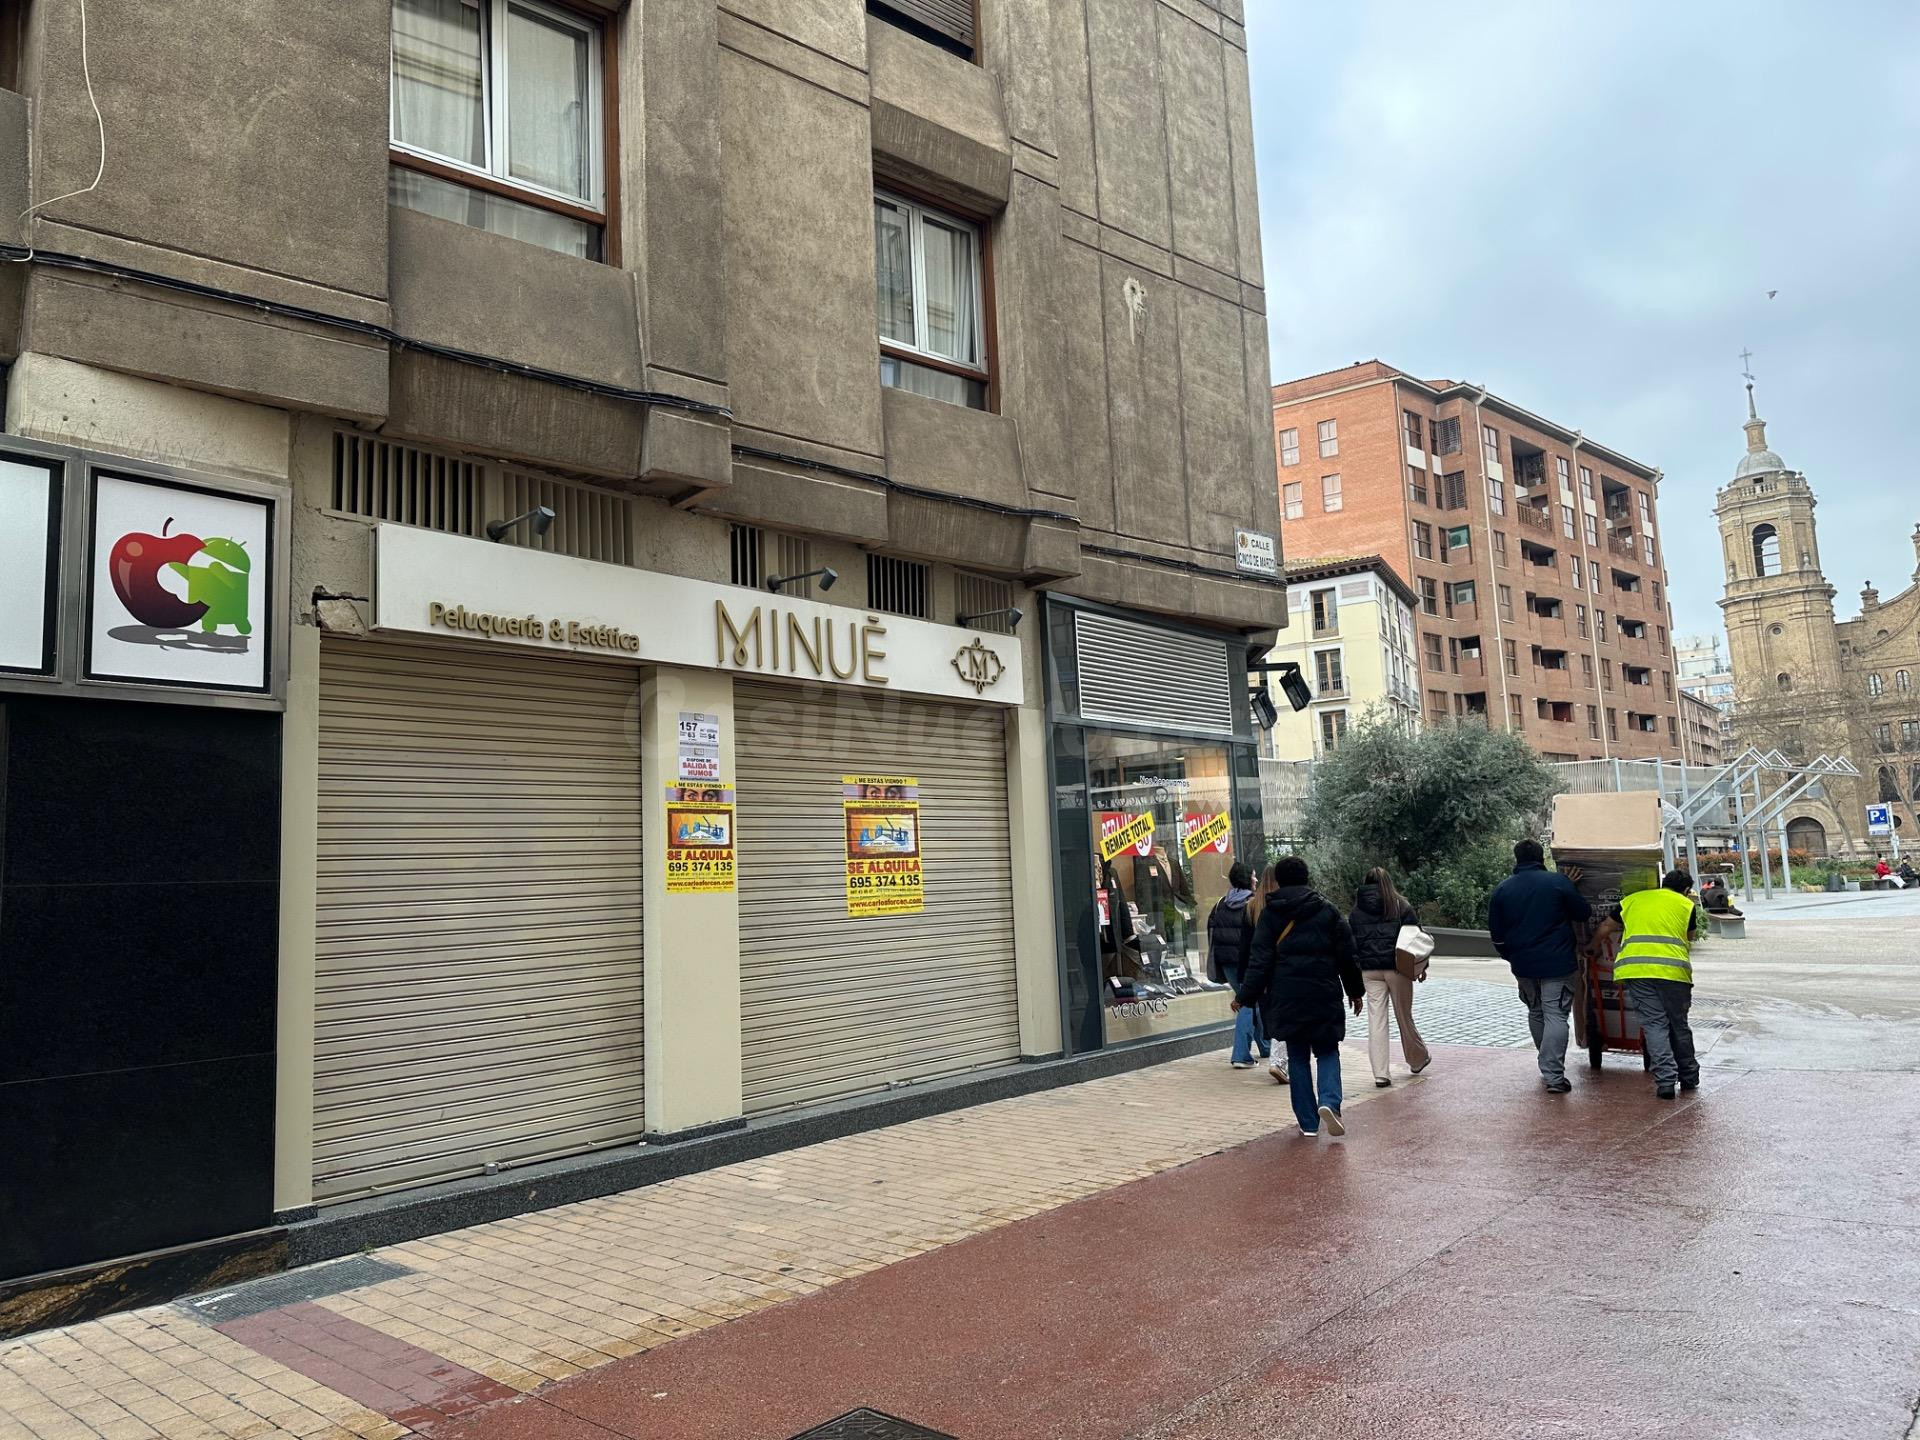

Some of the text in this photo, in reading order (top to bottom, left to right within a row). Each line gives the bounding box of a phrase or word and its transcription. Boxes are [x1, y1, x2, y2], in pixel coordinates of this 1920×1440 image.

[1251, 539, 1270, 551] CALLE
[429, 601, 640, 651] Peluquería & Estética
[680, 721, 698, 731] 157
[682, 762, 707, 770] SALIDA
[1105, 828, 1132, 856] REMATE
[1130, 817, 1151, 839] TOTAL
[1187, 827, 1211, 853] REMATE
[1209, 816, 1227, 838] TOTAL
[667, 850, 734, 861] SE ALQUILA
[668, 862, 733, 872] 695 374 135
[847, 859, 921, 874] SE ALQUILA
[850, 874, 920, 888] 695 374 135
